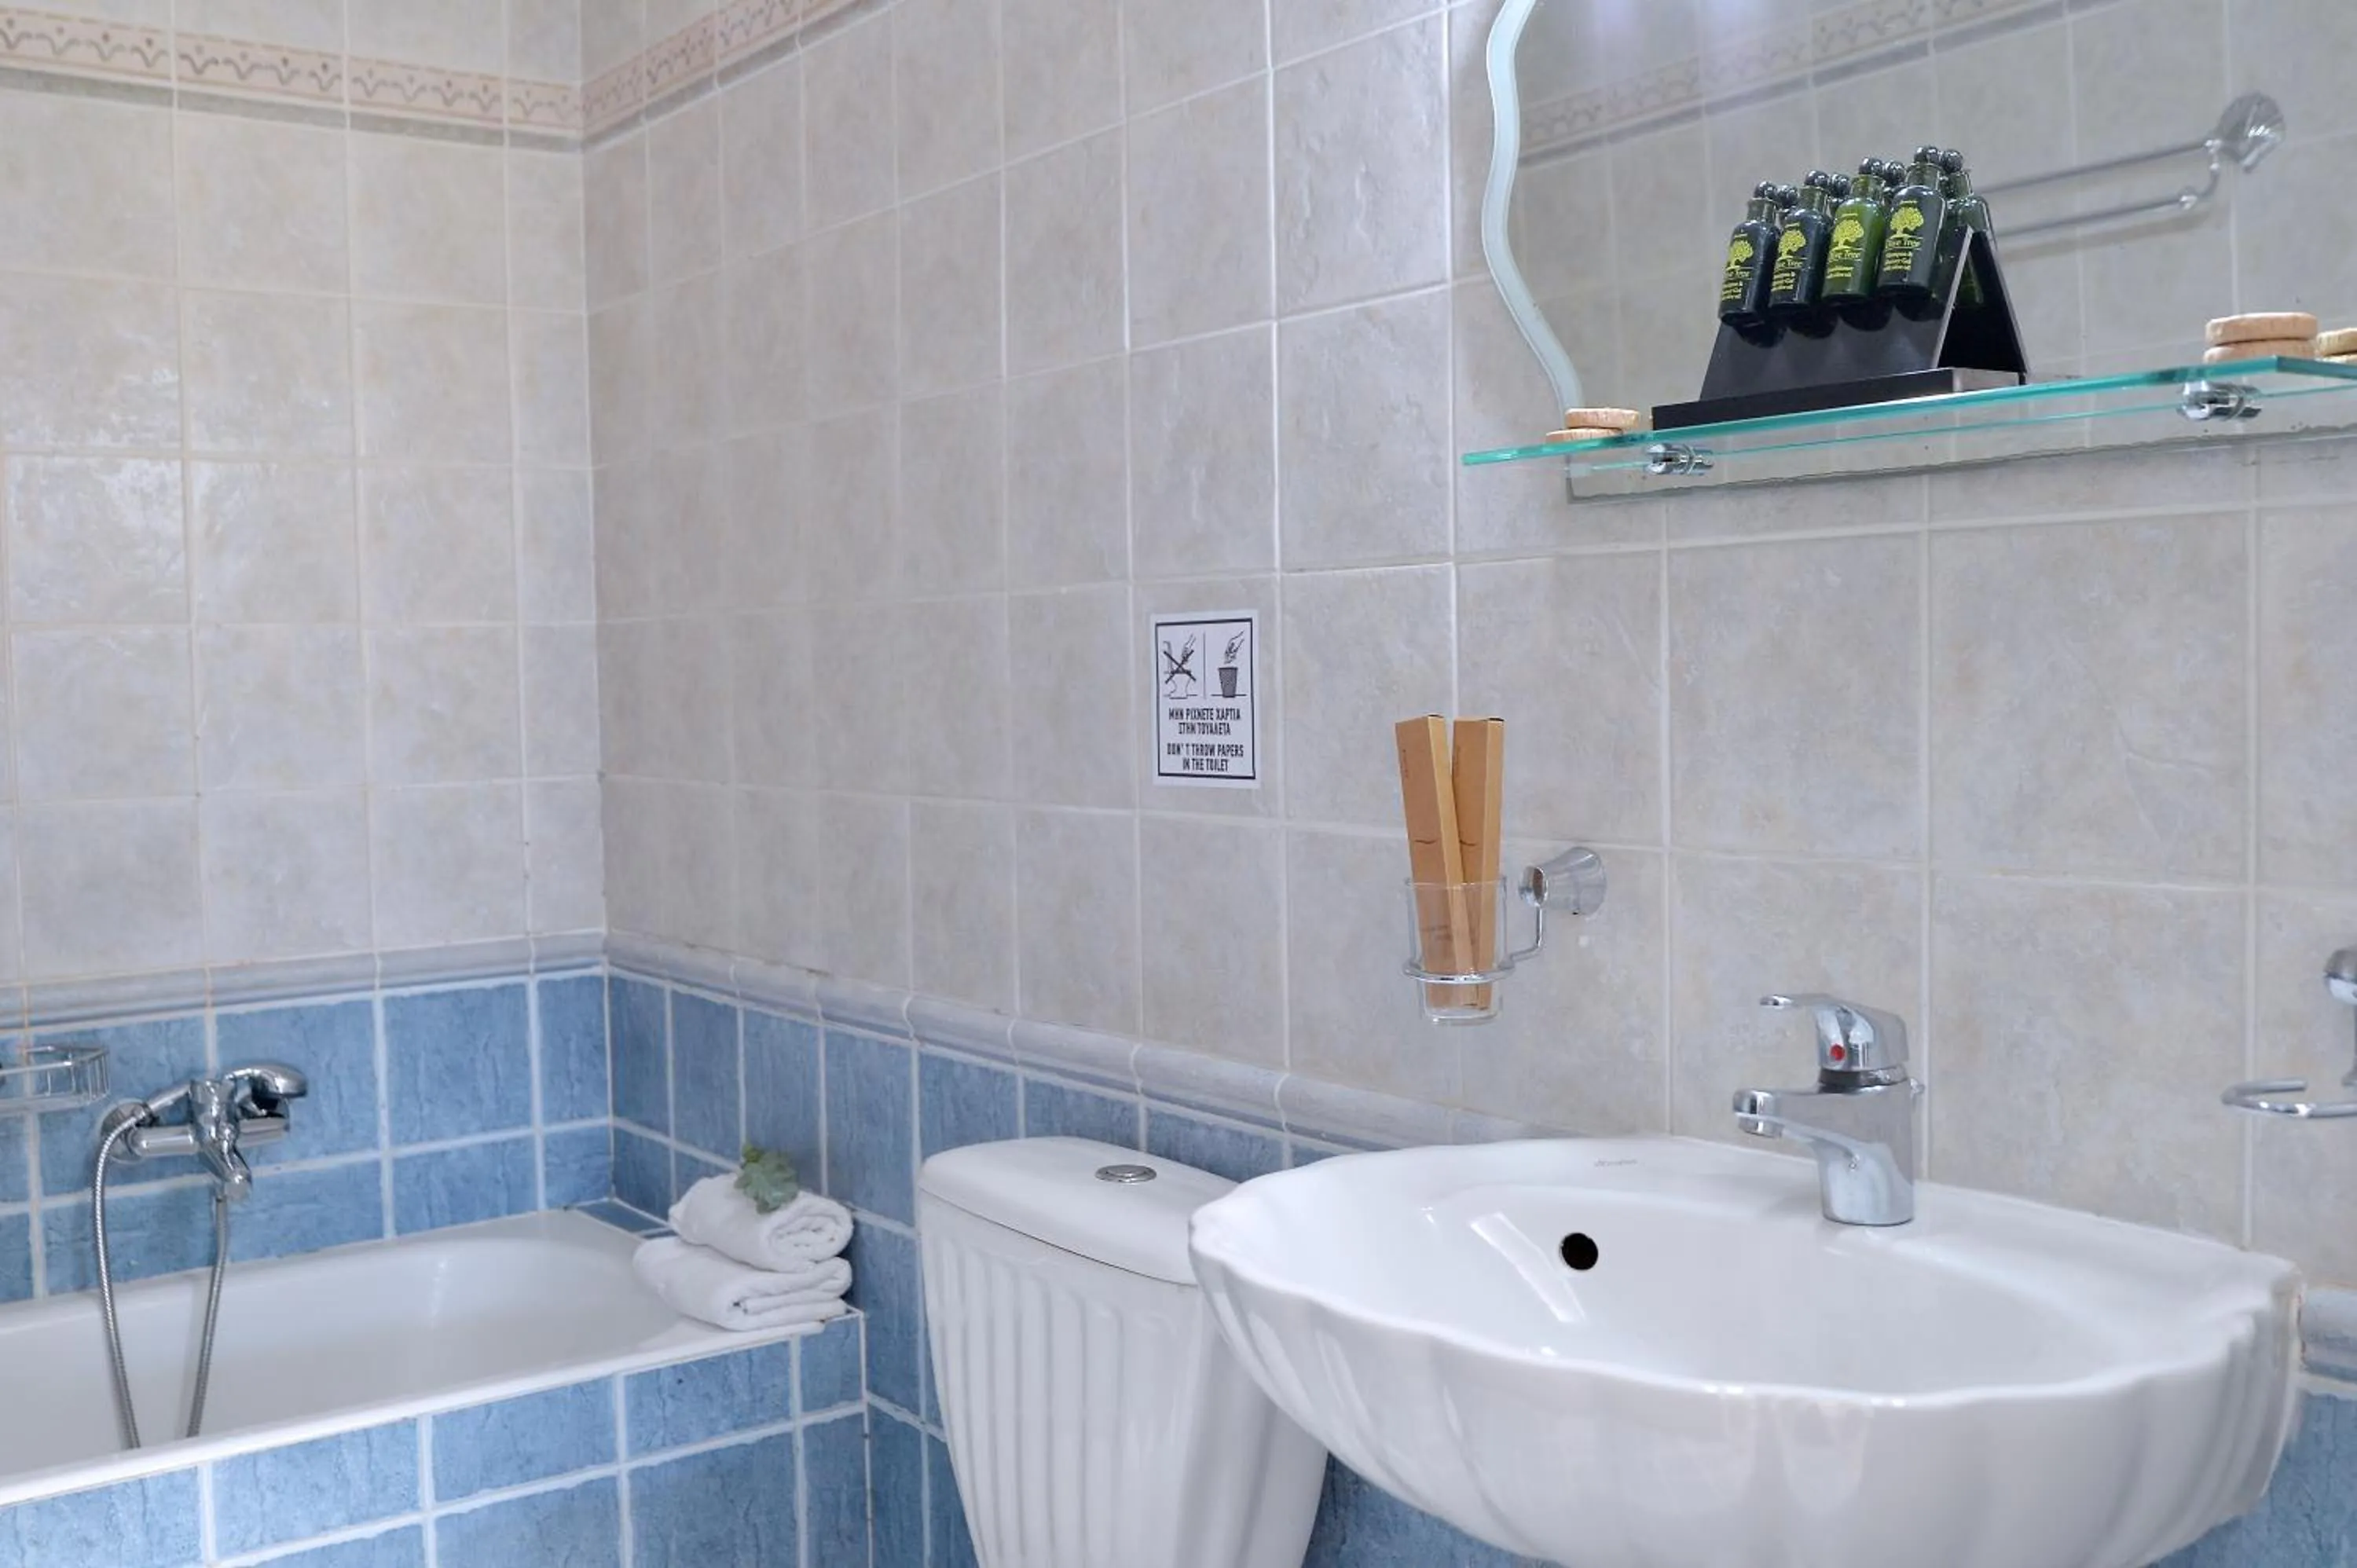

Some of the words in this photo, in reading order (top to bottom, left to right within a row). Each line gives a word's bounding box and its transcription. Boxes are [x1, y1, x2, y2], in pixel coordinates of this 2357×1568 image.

[1192, 743, 1215, 757] THROW
[1217, 743, 1244, 757] PAPERS
[1182, 758, 1190, 771] IN
[1192, 758, 1204, 771] THE
[1206, 758, 1230, 772] TOILET
